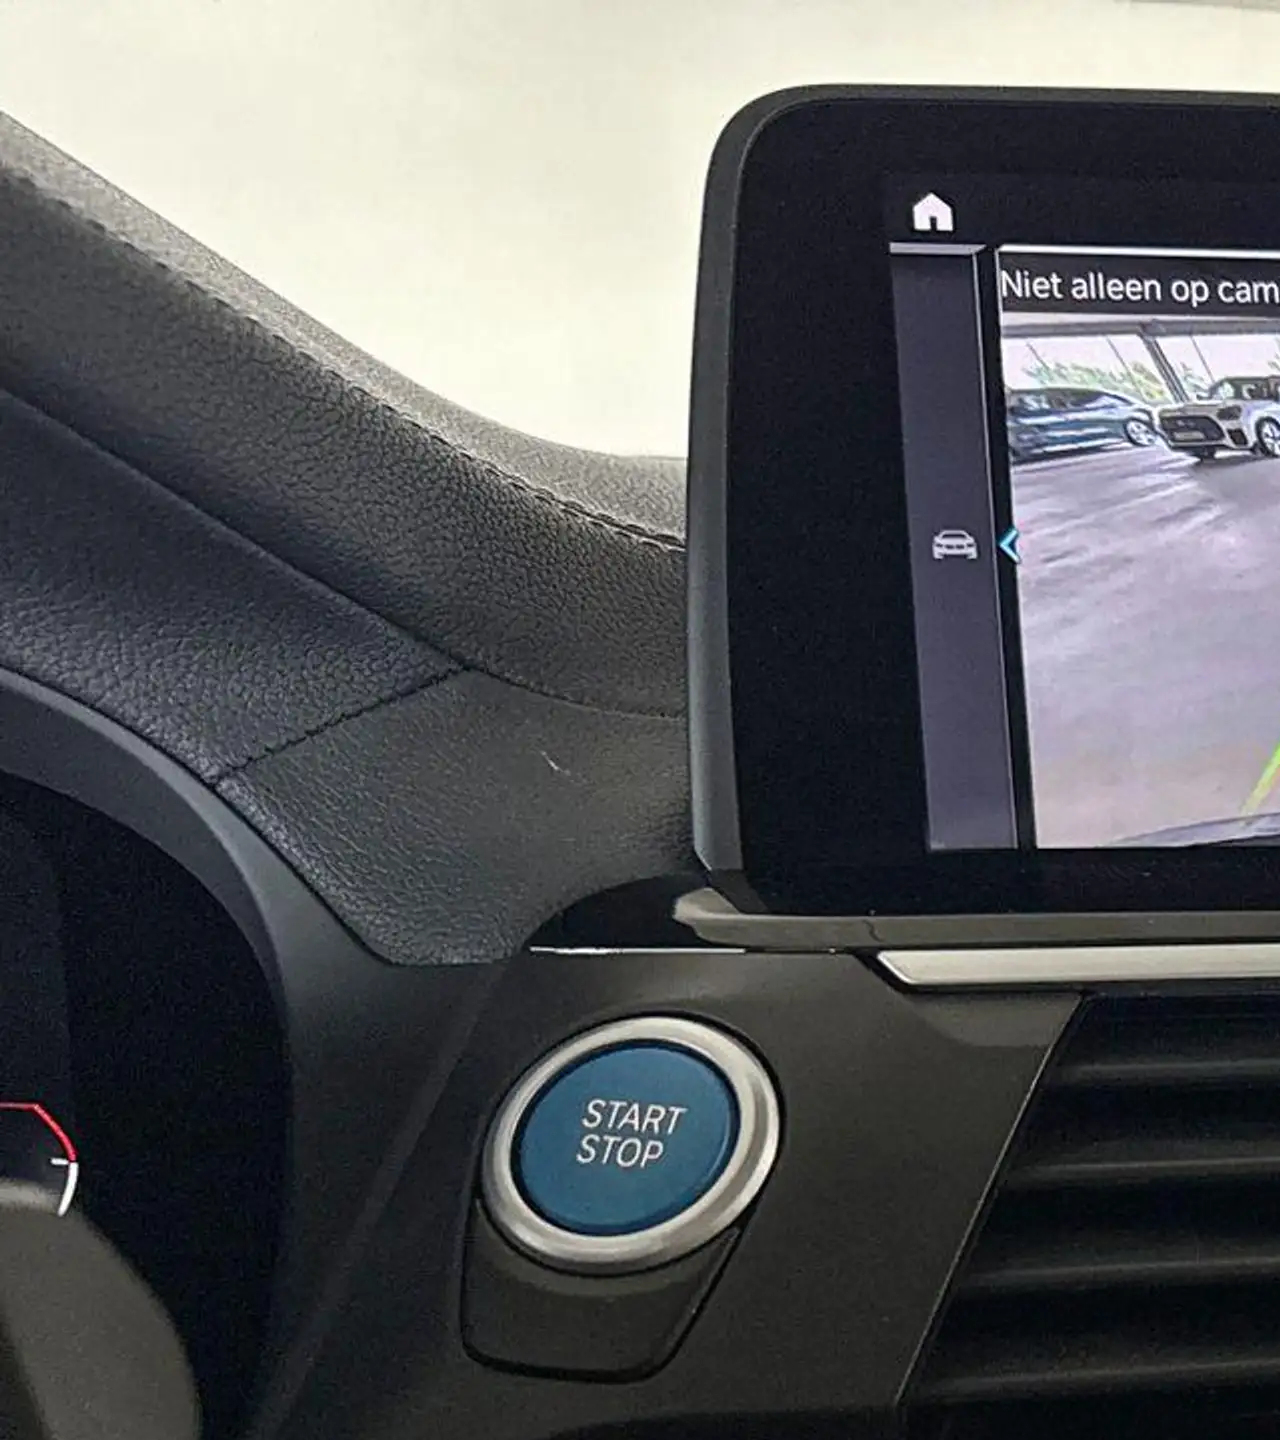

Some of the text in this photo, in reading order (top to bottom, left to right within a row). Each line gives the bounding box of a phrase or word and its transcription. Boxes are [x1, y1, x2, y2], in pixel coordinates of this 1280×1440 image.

[1001, 269, 1064, 300] Niet
[1070, 270, 1163, 304] alleen
[1170, 281, 1212, 308] op
[581, 1098, 689, 1136] START
[575, 1133, 664, 1169] STOP
